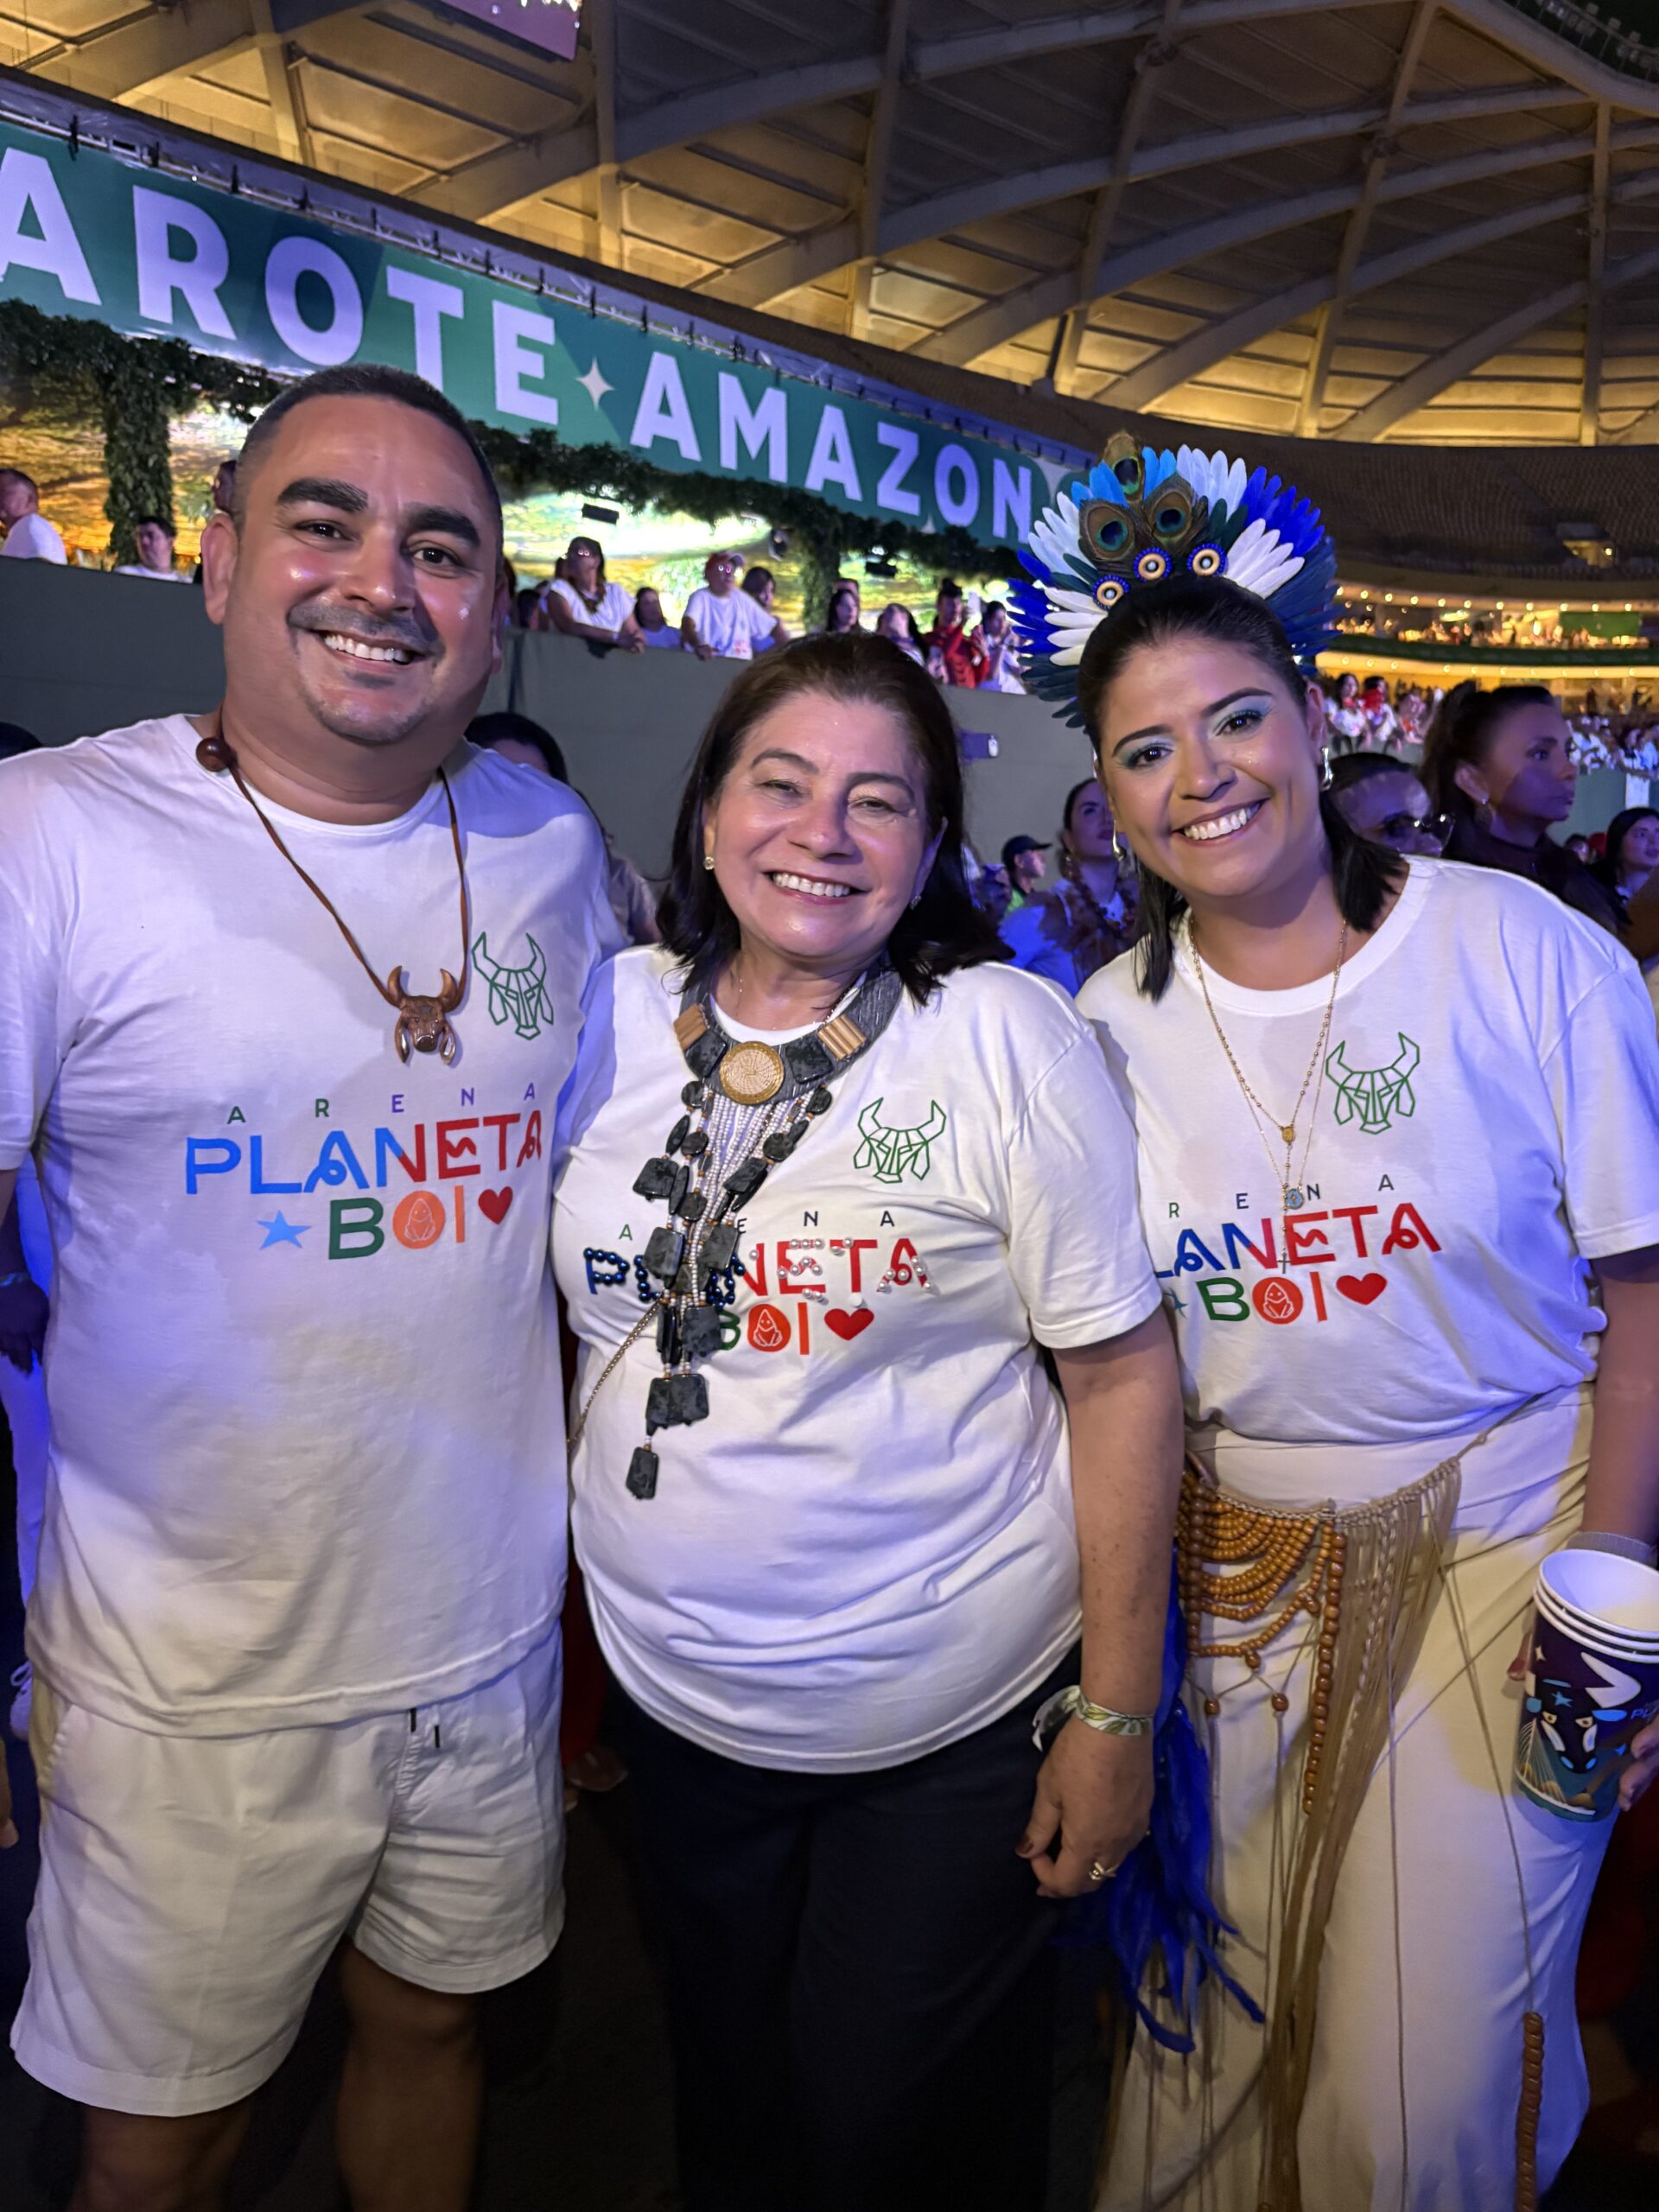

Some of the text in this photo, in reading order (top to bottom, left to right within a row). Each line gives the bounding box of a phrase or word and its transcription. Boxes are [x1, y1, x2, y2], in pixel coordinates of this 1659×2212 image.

[0, 147, 1032, 544] AROTE AMAZON
[227, 1083, 537, 1125] ARENA
[185, 1109, 542, 1195] PLANETA
[327, 1185, 466, 1261] BOI
[619, 1211, 895, 1242] AENA
[1168, 1173, 1395, 1218] RENA
[1154, 1203, 1441, 1279] ANETA
[1195, 1271, 1328, 1325] BOI
